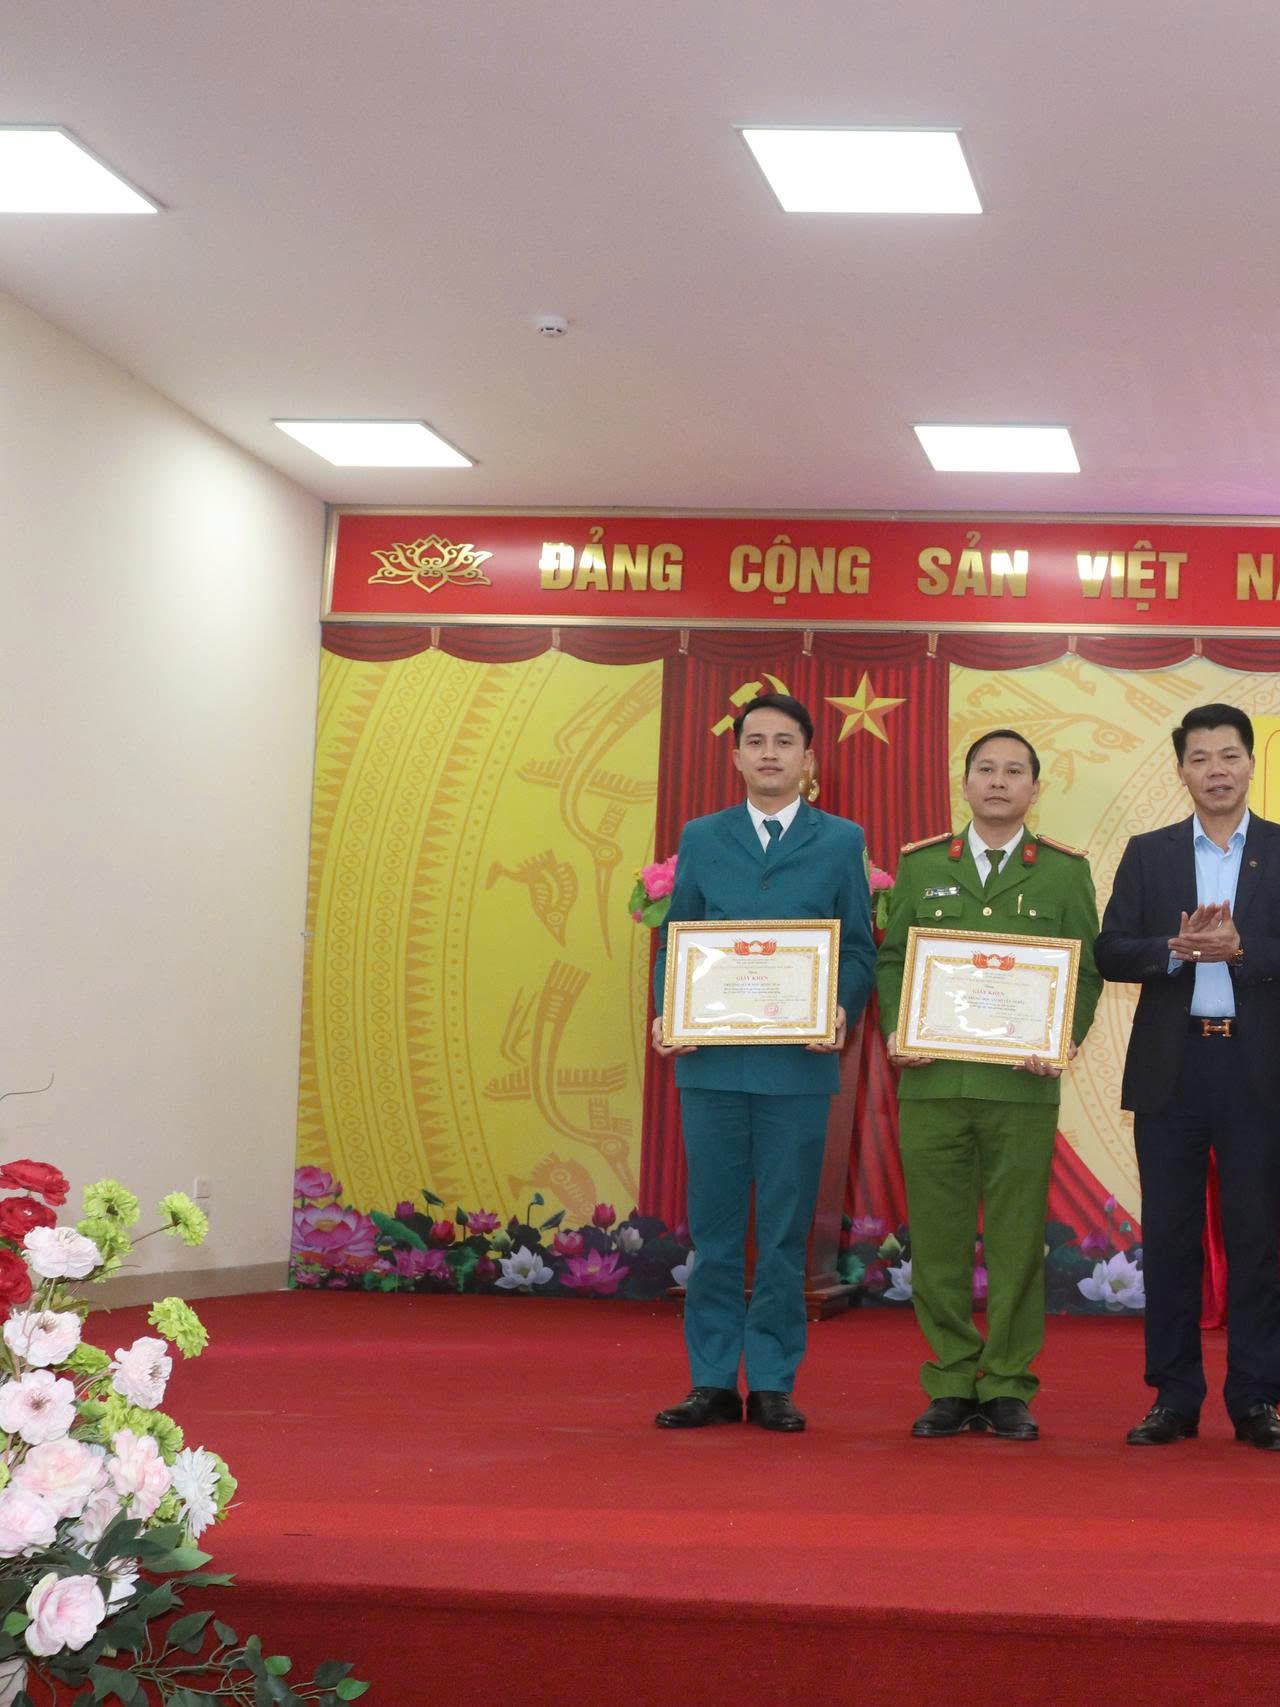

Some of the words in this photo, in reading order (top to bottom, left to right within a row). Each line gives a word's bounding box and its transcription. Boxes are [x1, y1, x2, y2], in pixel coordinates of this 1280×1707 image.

[539, 526, 683, 591] ĐẢNG
[729, 534, 871, 604] CỘNG
[917, 530, 1029, 597] SẢN
[1076, 539, 1188, 611] VIỆT
